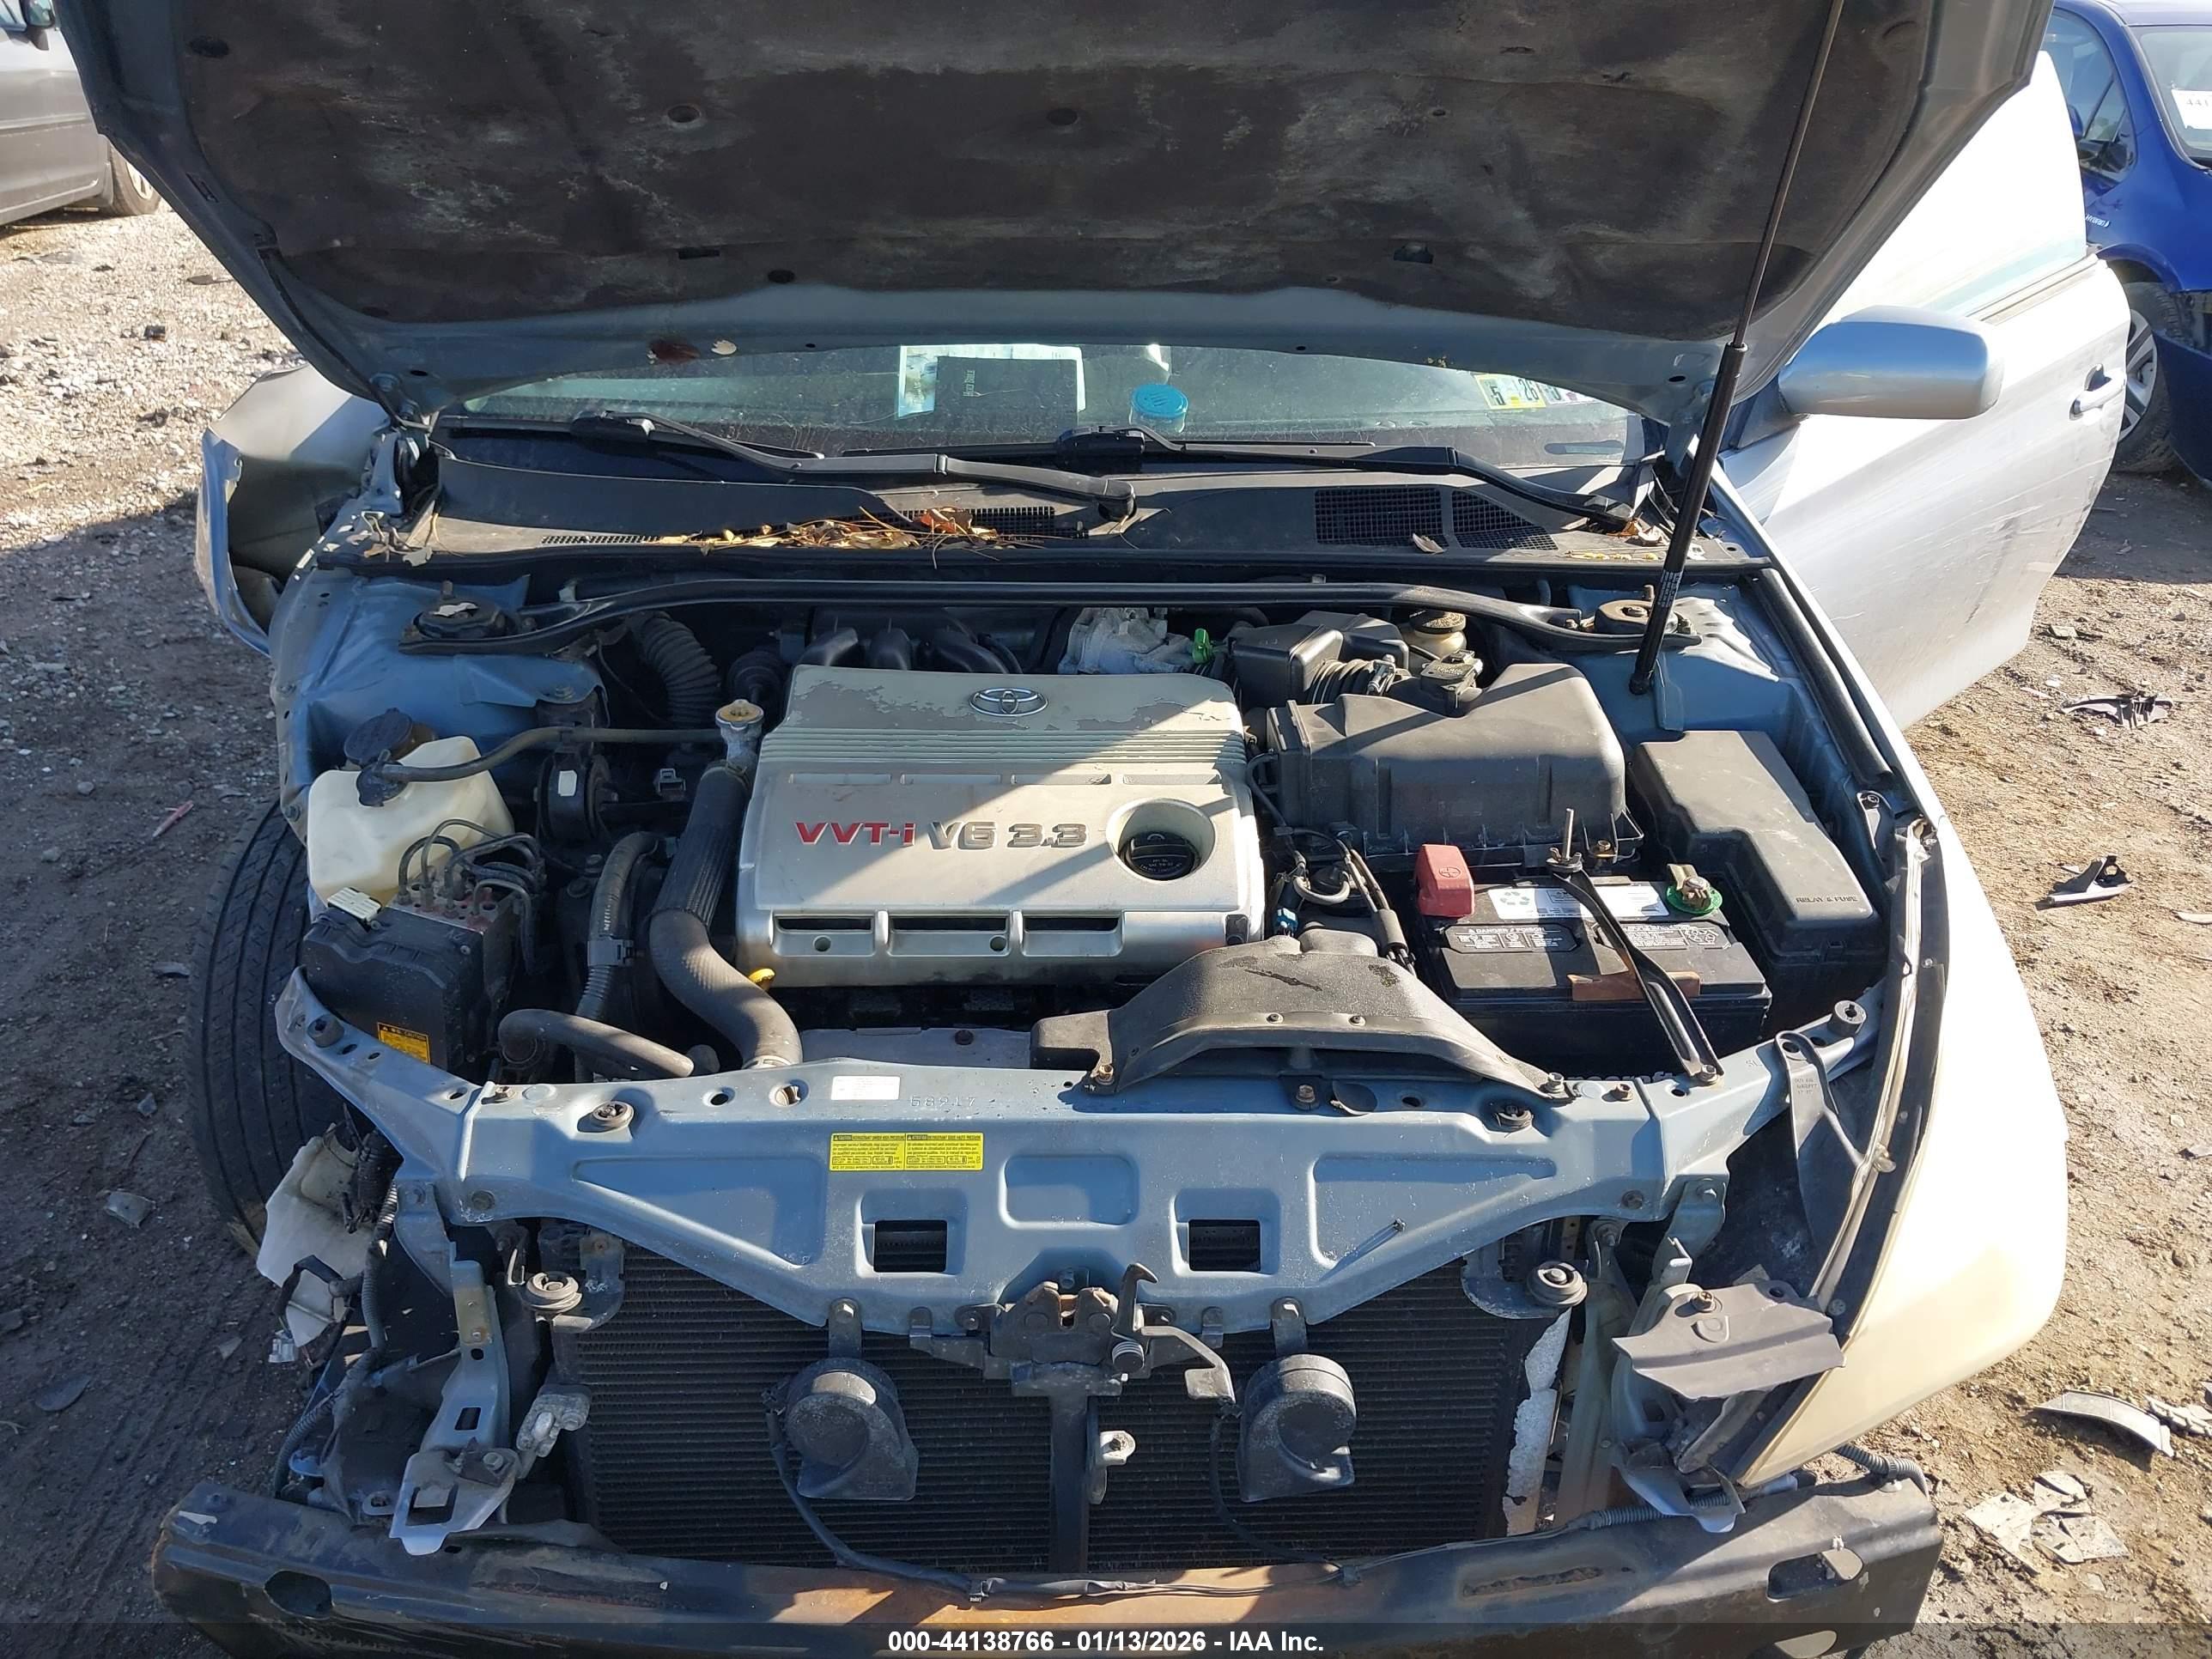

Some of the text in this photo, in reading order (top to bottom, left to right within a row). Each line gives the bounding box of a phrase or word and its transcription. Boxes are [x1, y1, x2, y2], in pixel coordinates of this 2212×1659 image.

[795, 820, 1089, 851] VVT-i V6 3.3
